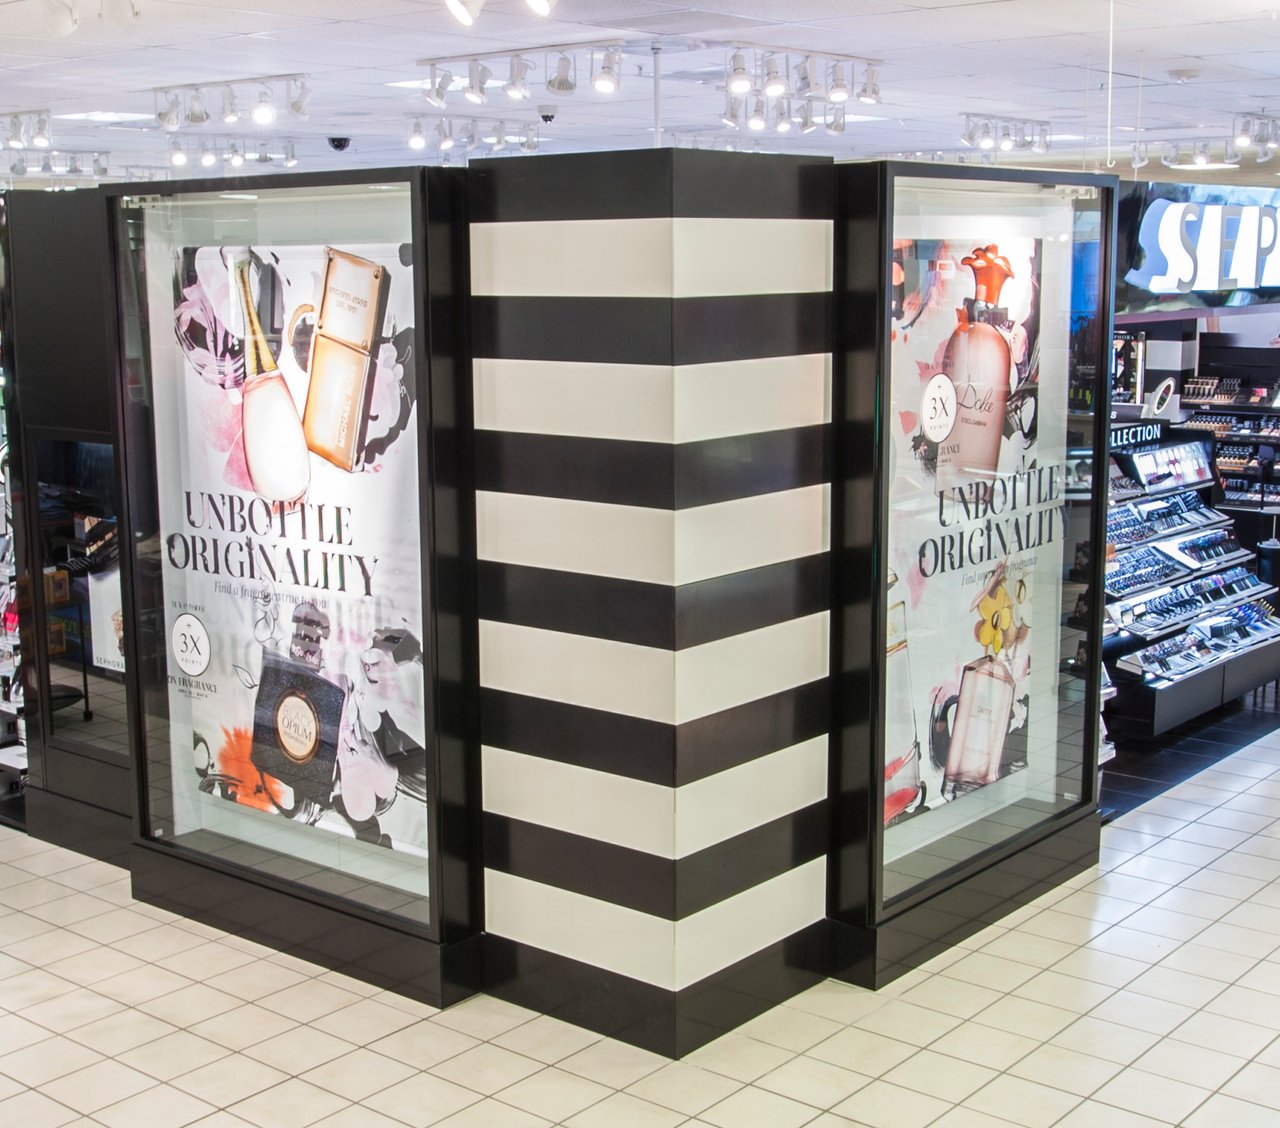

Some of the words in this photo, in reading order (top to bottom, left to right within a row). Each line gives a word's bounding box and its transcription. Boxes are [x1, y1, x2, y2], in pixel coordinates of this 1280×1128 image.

[929, 395, 949, 420] 3X
[956, 384, 994, 413] Dolce
[336, 400, 351, 448] MICHAEL
[938, 465, 1060, 528] UNBOTTLE
[185, 490, 354, 546] UNBOTTLE
[918, 506, 1070, 578] ORIGINALITY
[166, 531, 380, 597] ORIGINALITY
[1009, 556, 1039, 577] fragrance
[214, 580, 232, 594] Find
[962, 571, 976, 586] Find
[178, 633, 202, 656] 3X
[95, 656, 124, 669] SEPHORA
[181, 658, 202, 666] POINTS
[178, 676, 218, 693] FRAGRANCE
[281, 718, 312, 742] OPIUM
